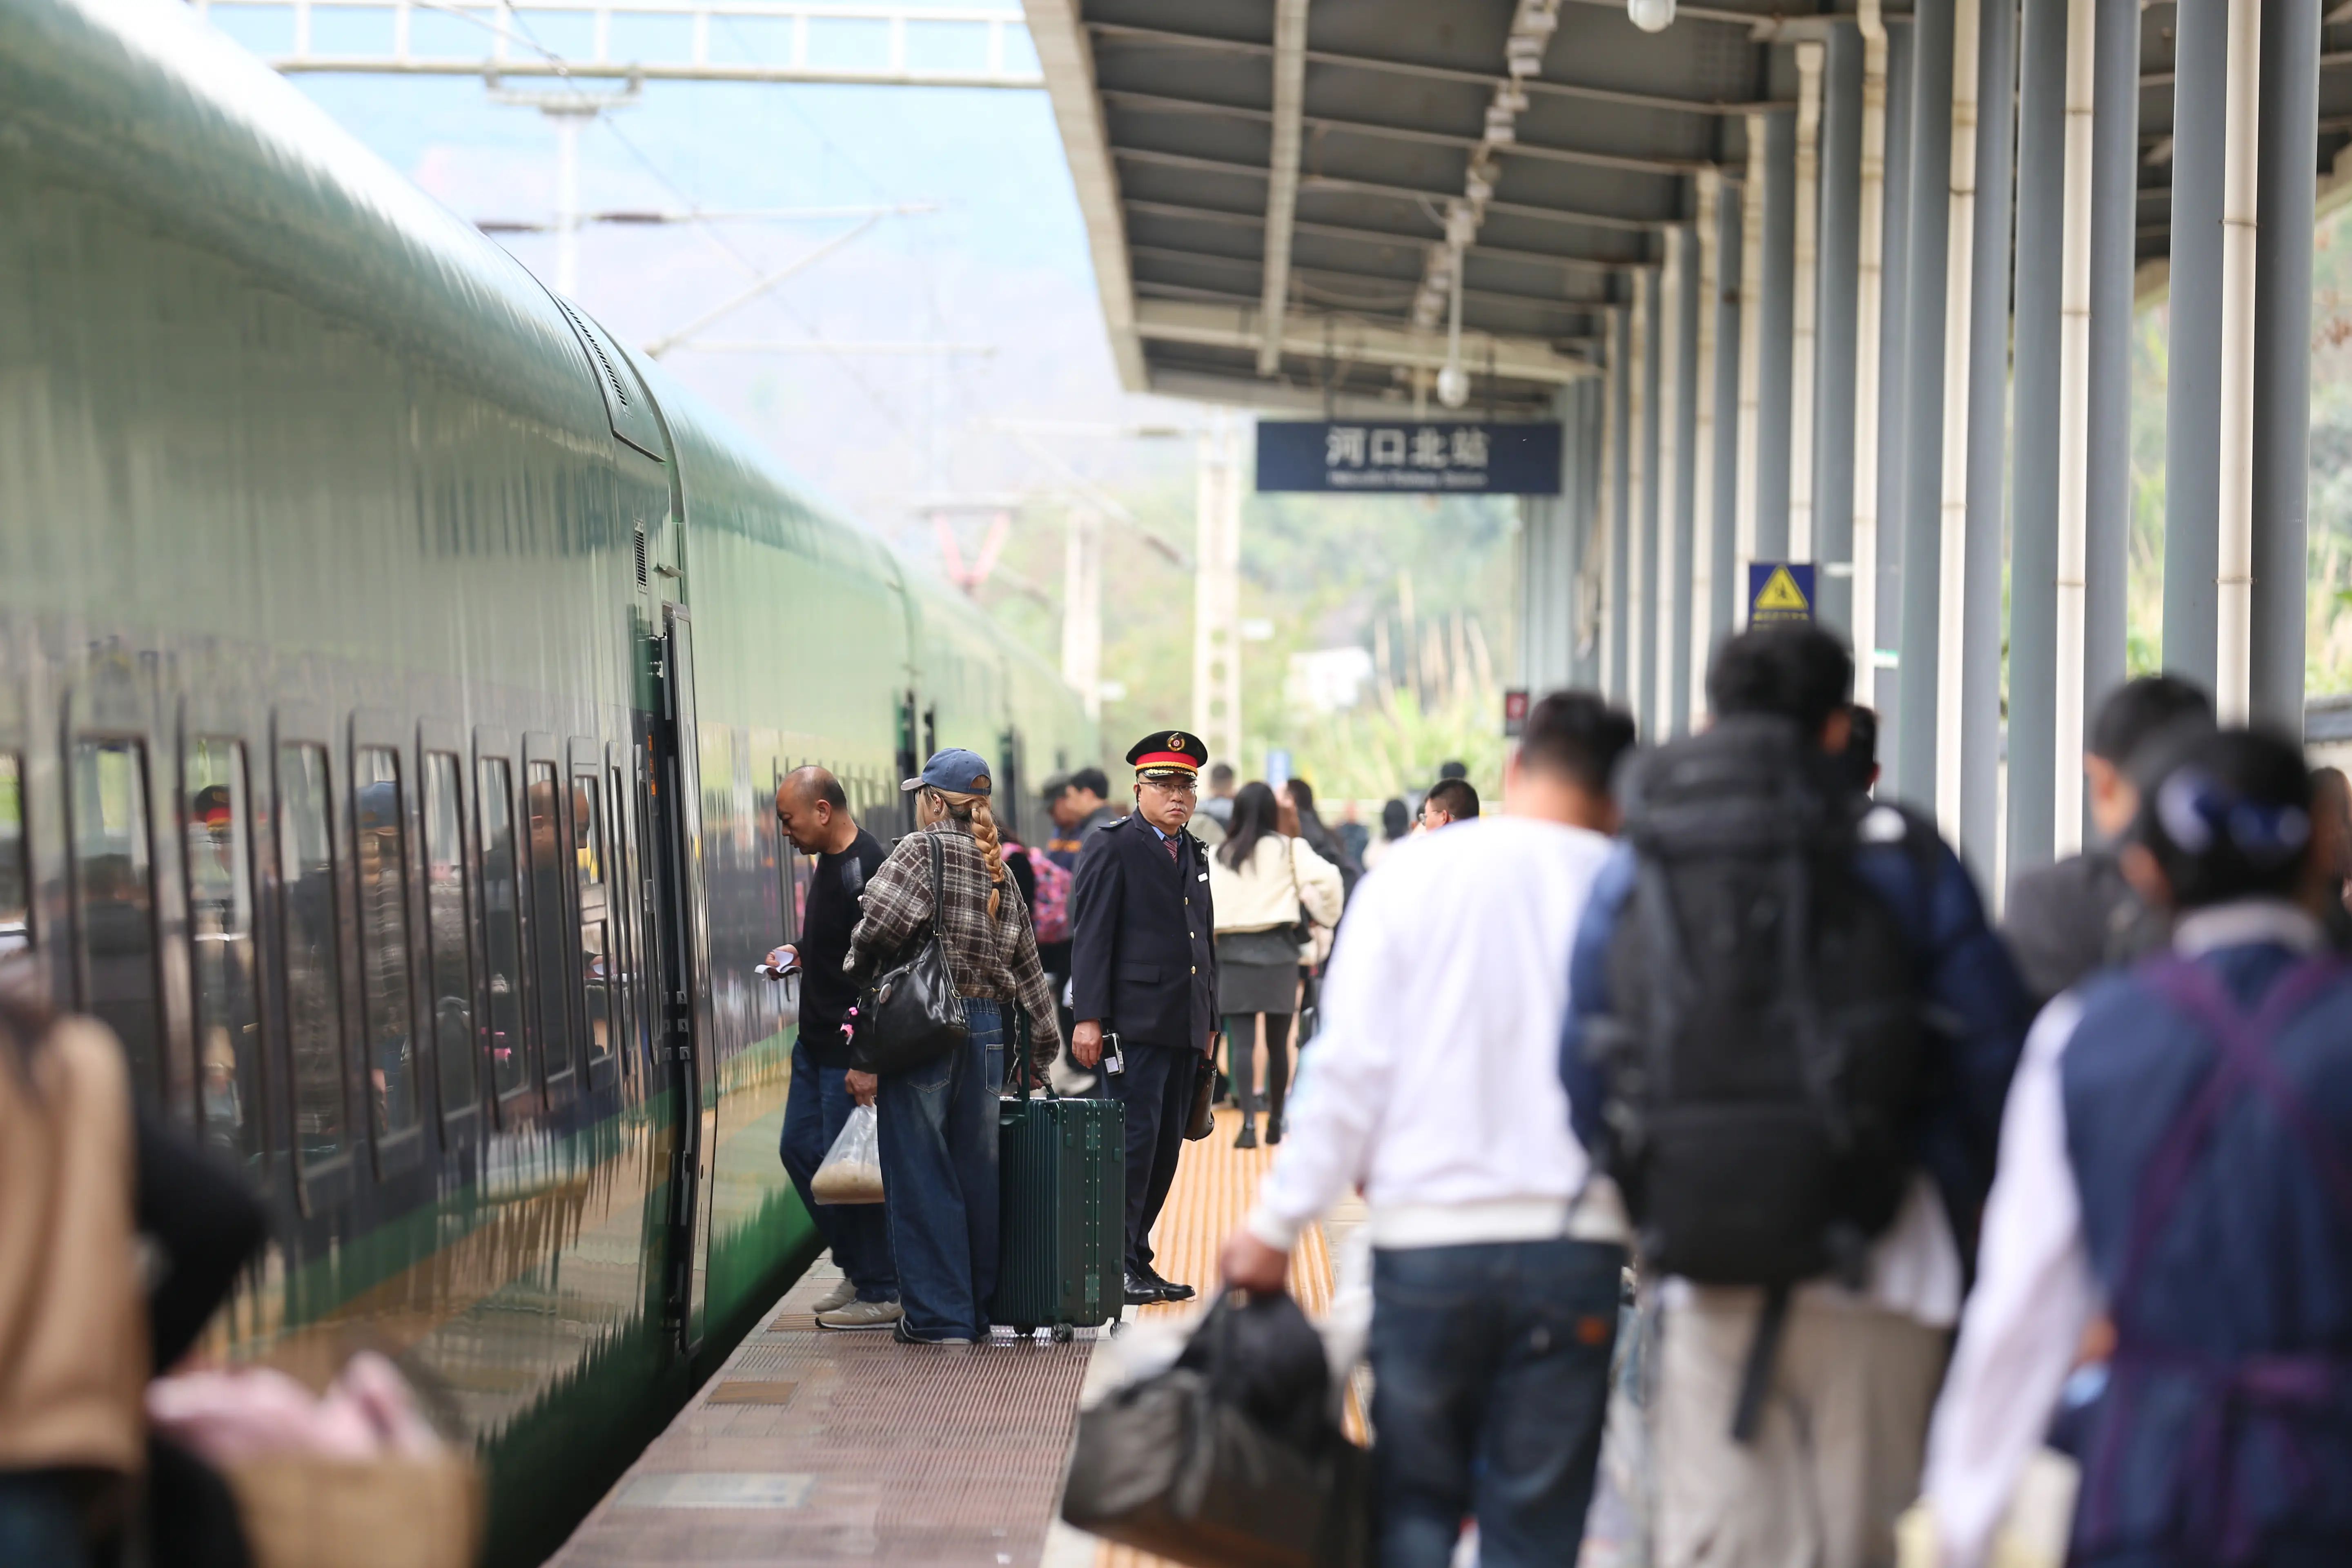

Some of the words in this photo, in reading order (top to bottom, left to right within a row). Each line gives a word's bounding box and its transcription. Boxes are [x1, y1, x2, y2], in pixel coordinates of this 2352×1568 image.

[1326, 427, 1489, 467] 河口北站
[865, 1306, 882, 1316] N
